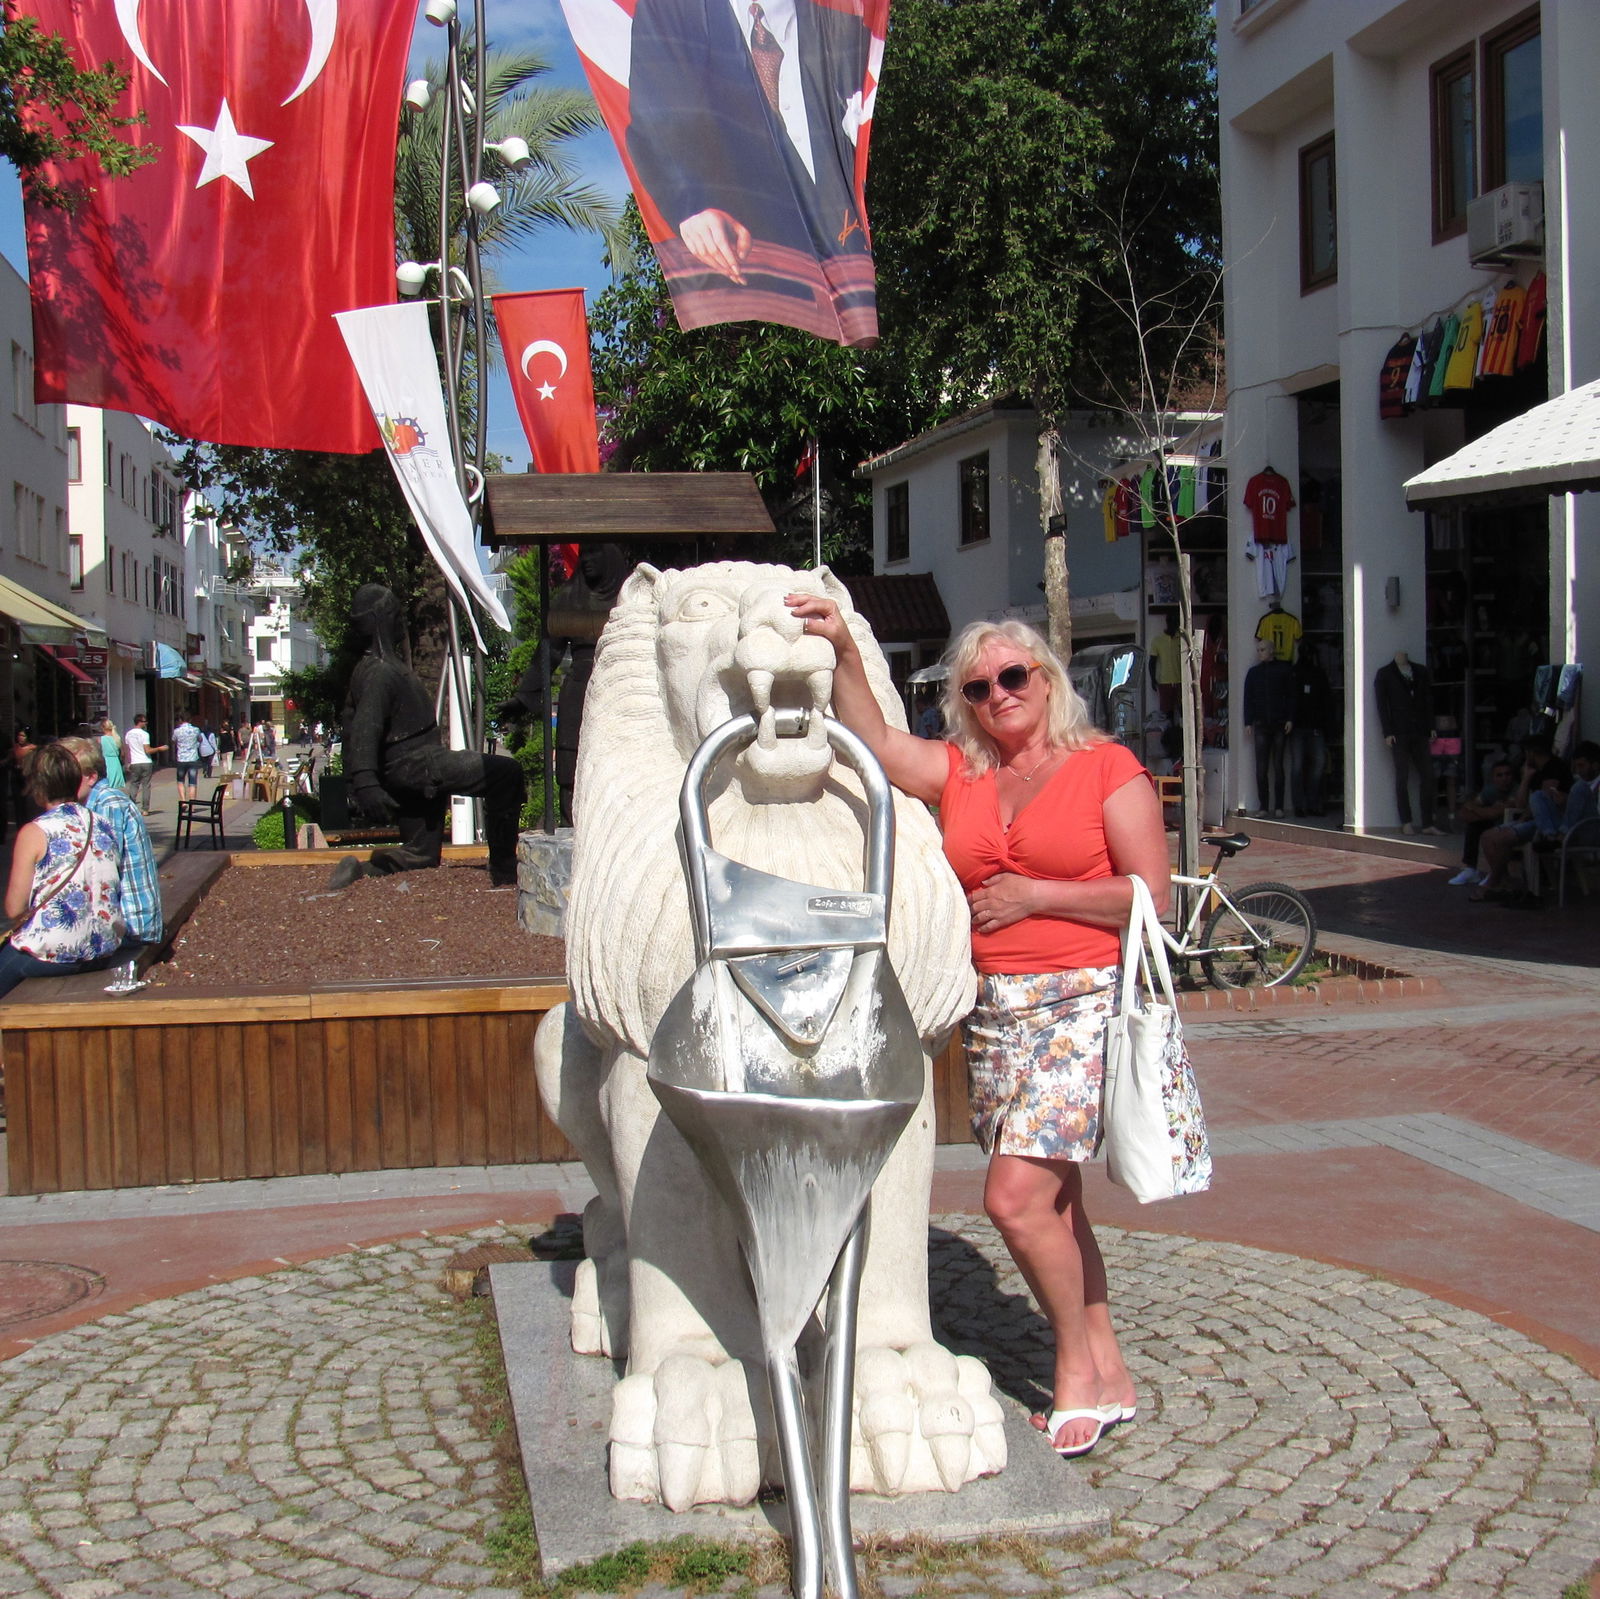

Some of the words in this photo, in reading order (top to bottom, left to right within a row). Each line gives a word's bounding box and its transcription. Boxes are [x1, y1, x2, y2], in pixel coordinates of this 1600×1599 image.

[1491, 312, 1509, 336] 10
[1390, 367, 1401, 389] 9
[1262, 495, 1277, 515] 10
[1273, 630, 1284, 650] 11
